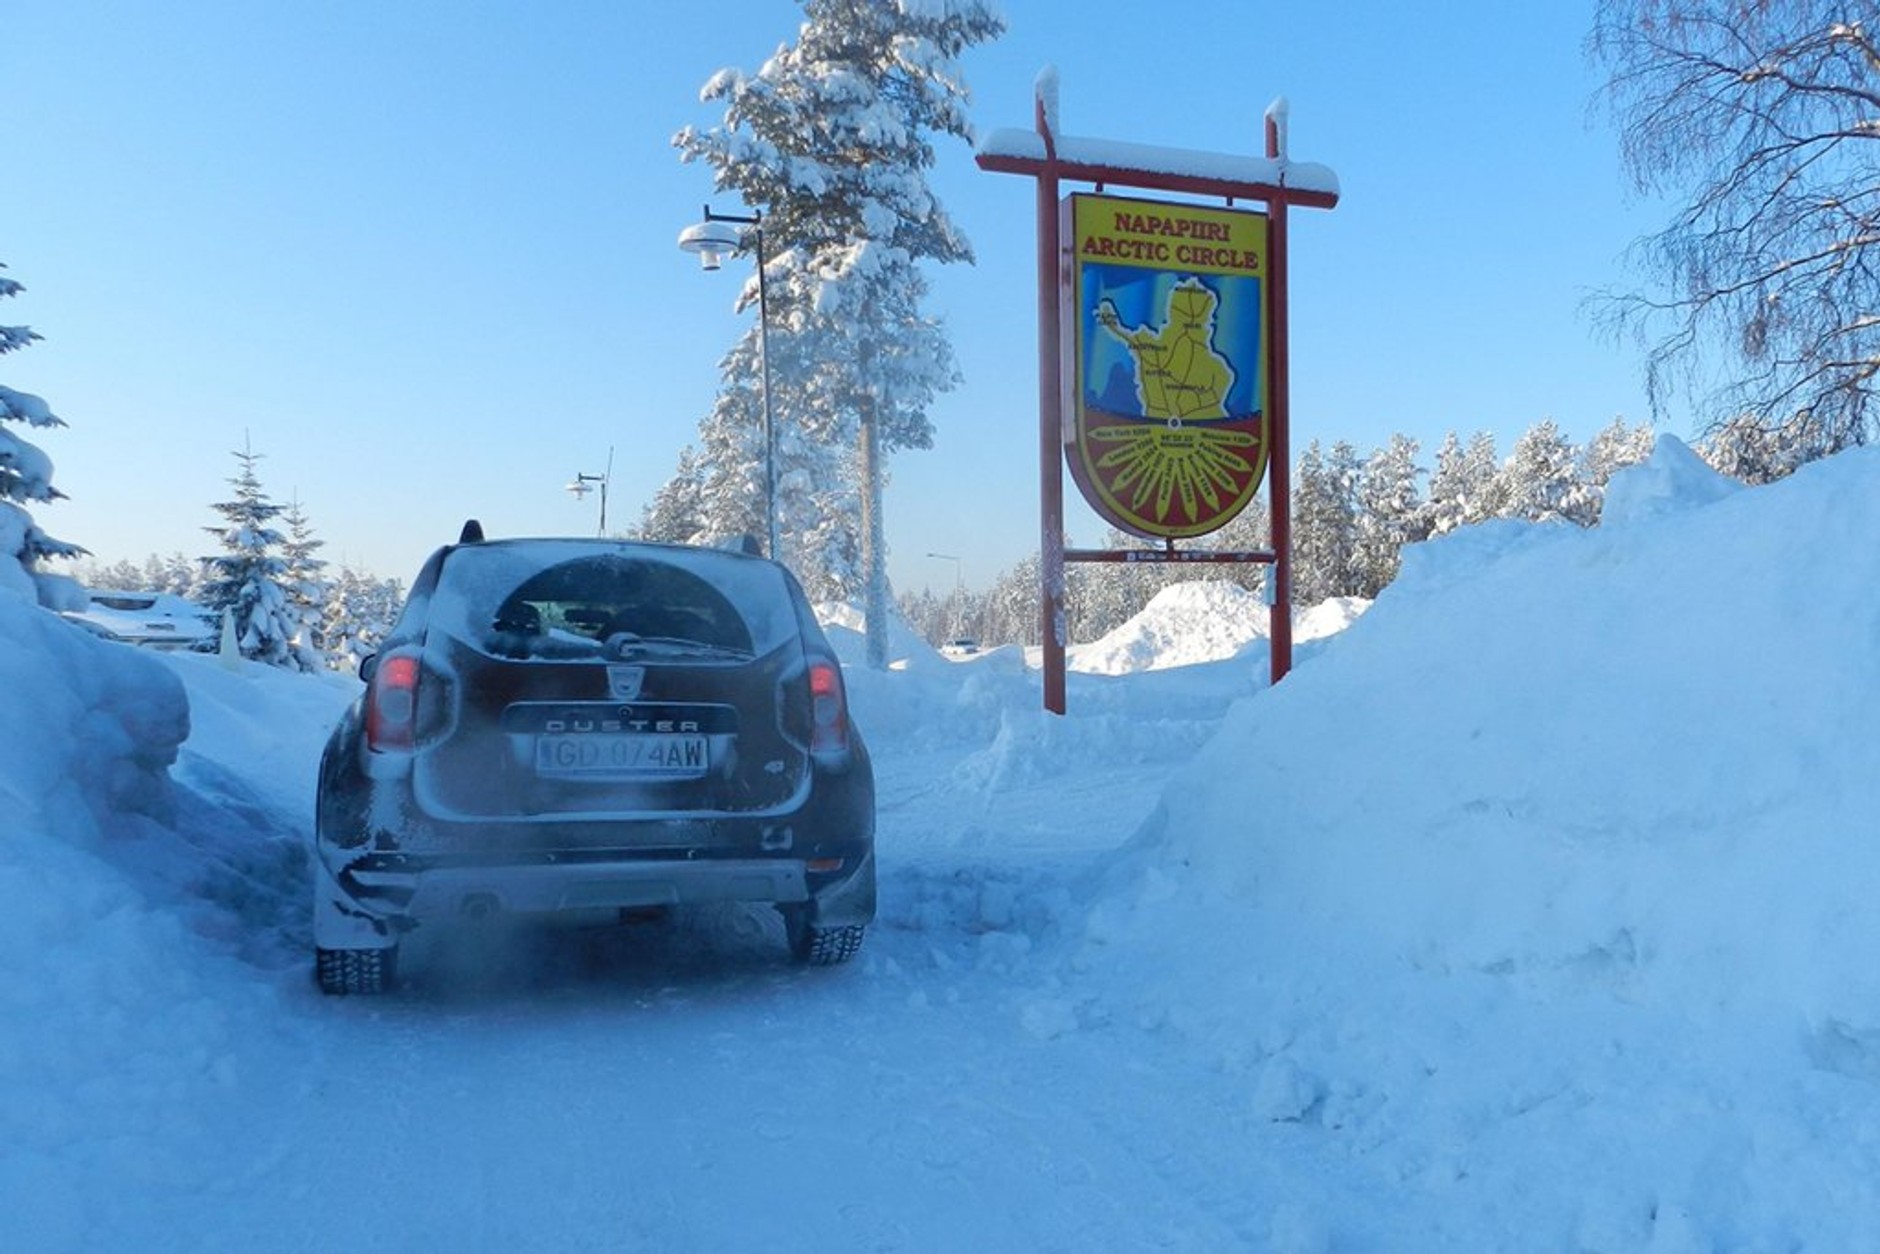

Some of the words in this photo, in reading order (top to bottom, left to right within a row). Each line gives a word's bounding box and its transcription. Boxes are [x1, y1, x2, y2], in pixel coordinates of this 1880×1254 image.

[1114, 212, 1231, 242] NAPAPIIRI
[1082, 235, 1170, 262] ARCTIC
[1176, 245, 1259, 270] CIRCLE
[545, 719, 699, 732] DUSTER
[556, 739, 599, 767] GD
